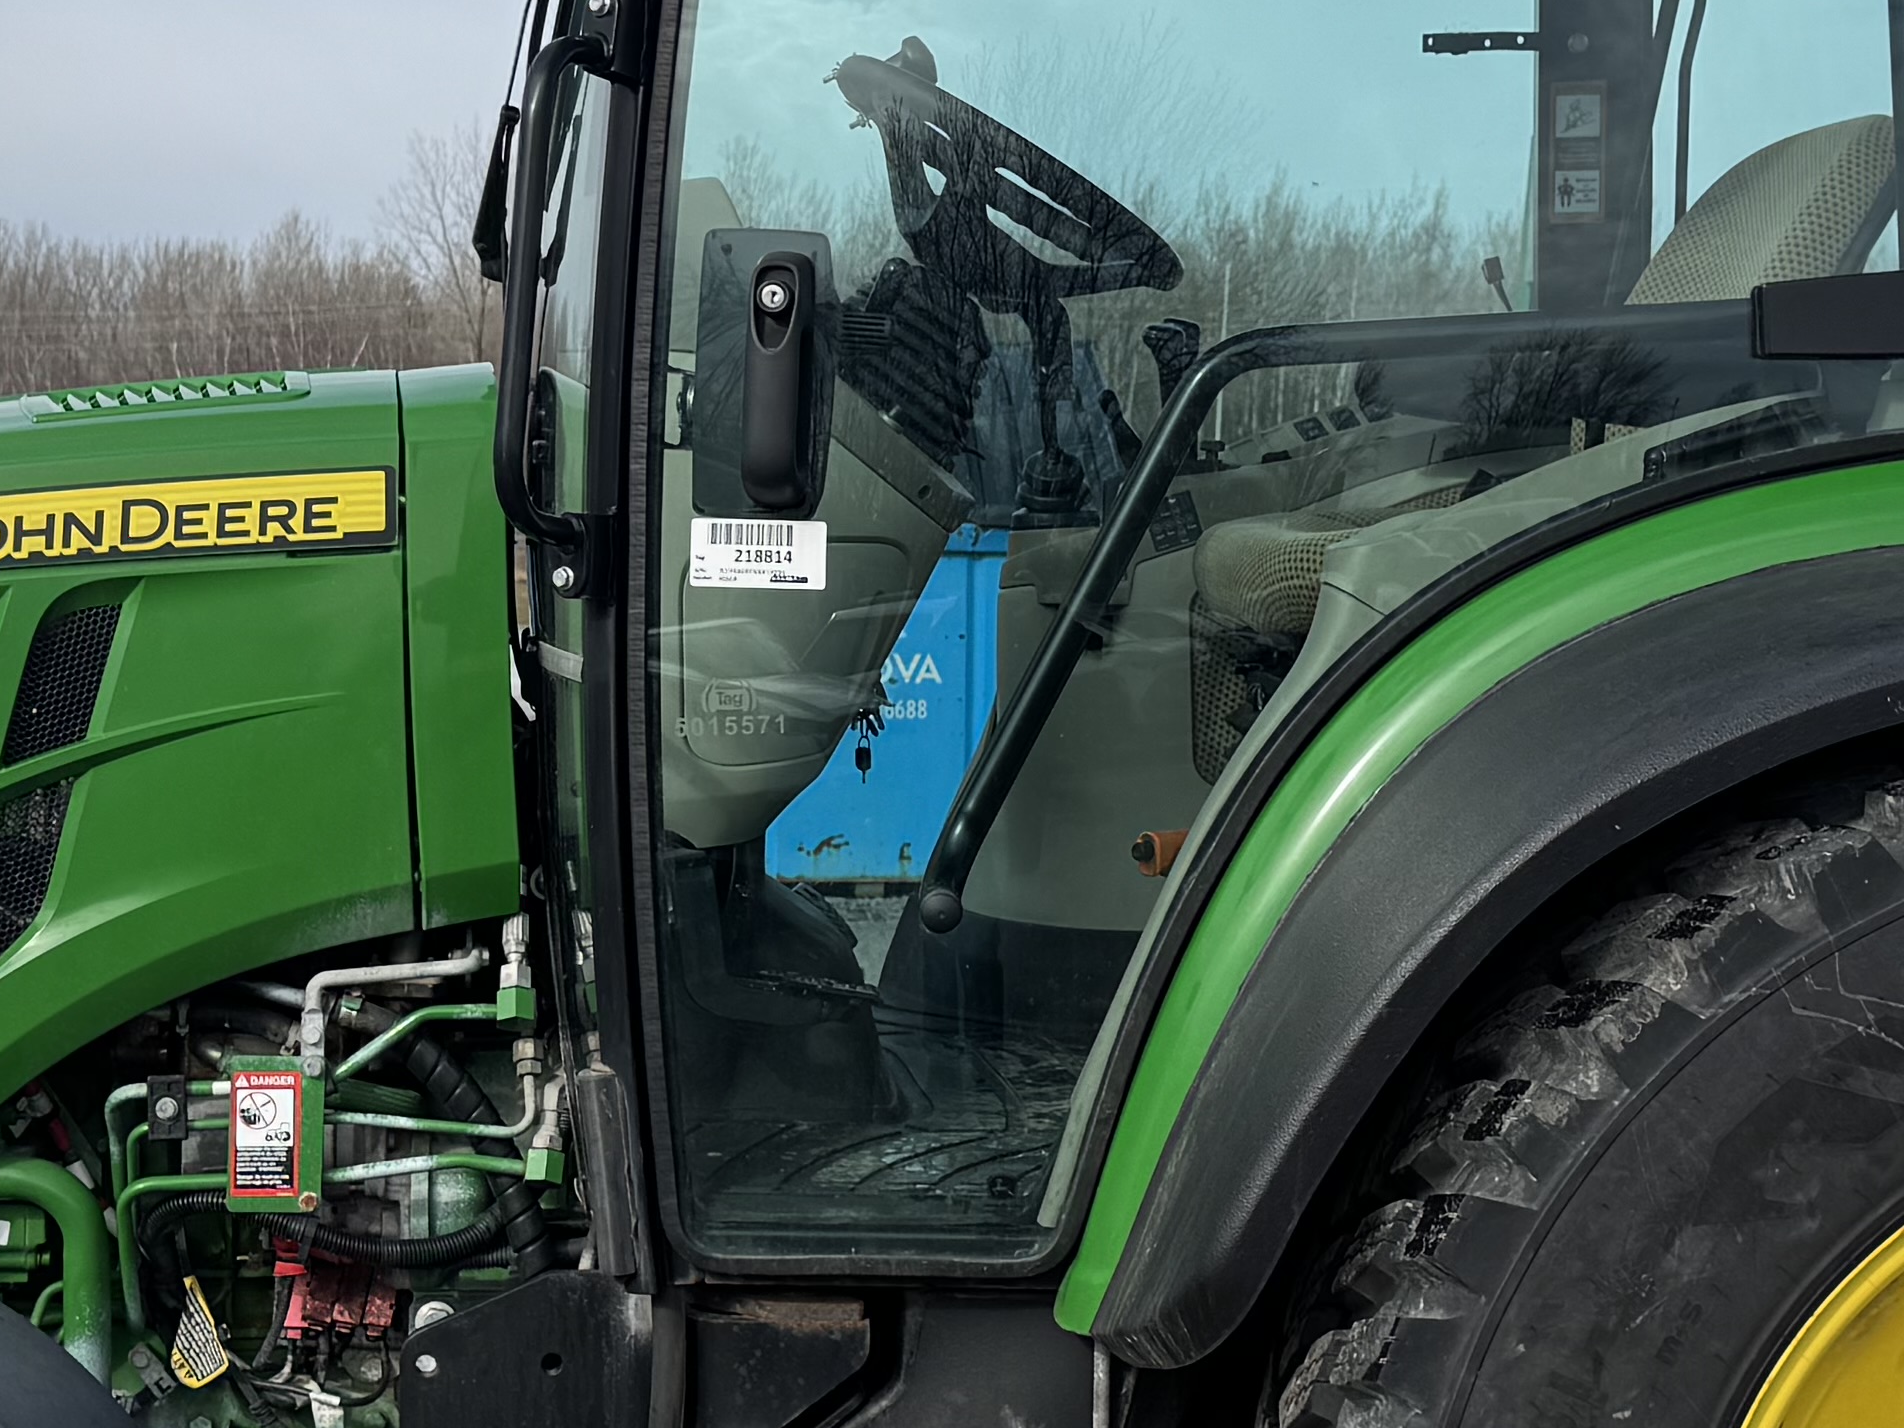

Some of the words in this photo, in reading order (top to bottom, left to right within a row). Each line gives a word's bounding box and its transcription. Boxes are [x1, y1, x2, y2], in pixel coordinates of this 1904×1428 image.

[119, 494, 340, 547] DEERE
[733, 548, 794, 565] 218814
[715, 690, 744, 708] Tag
[249, 1075, 296, 1087] DANGER
